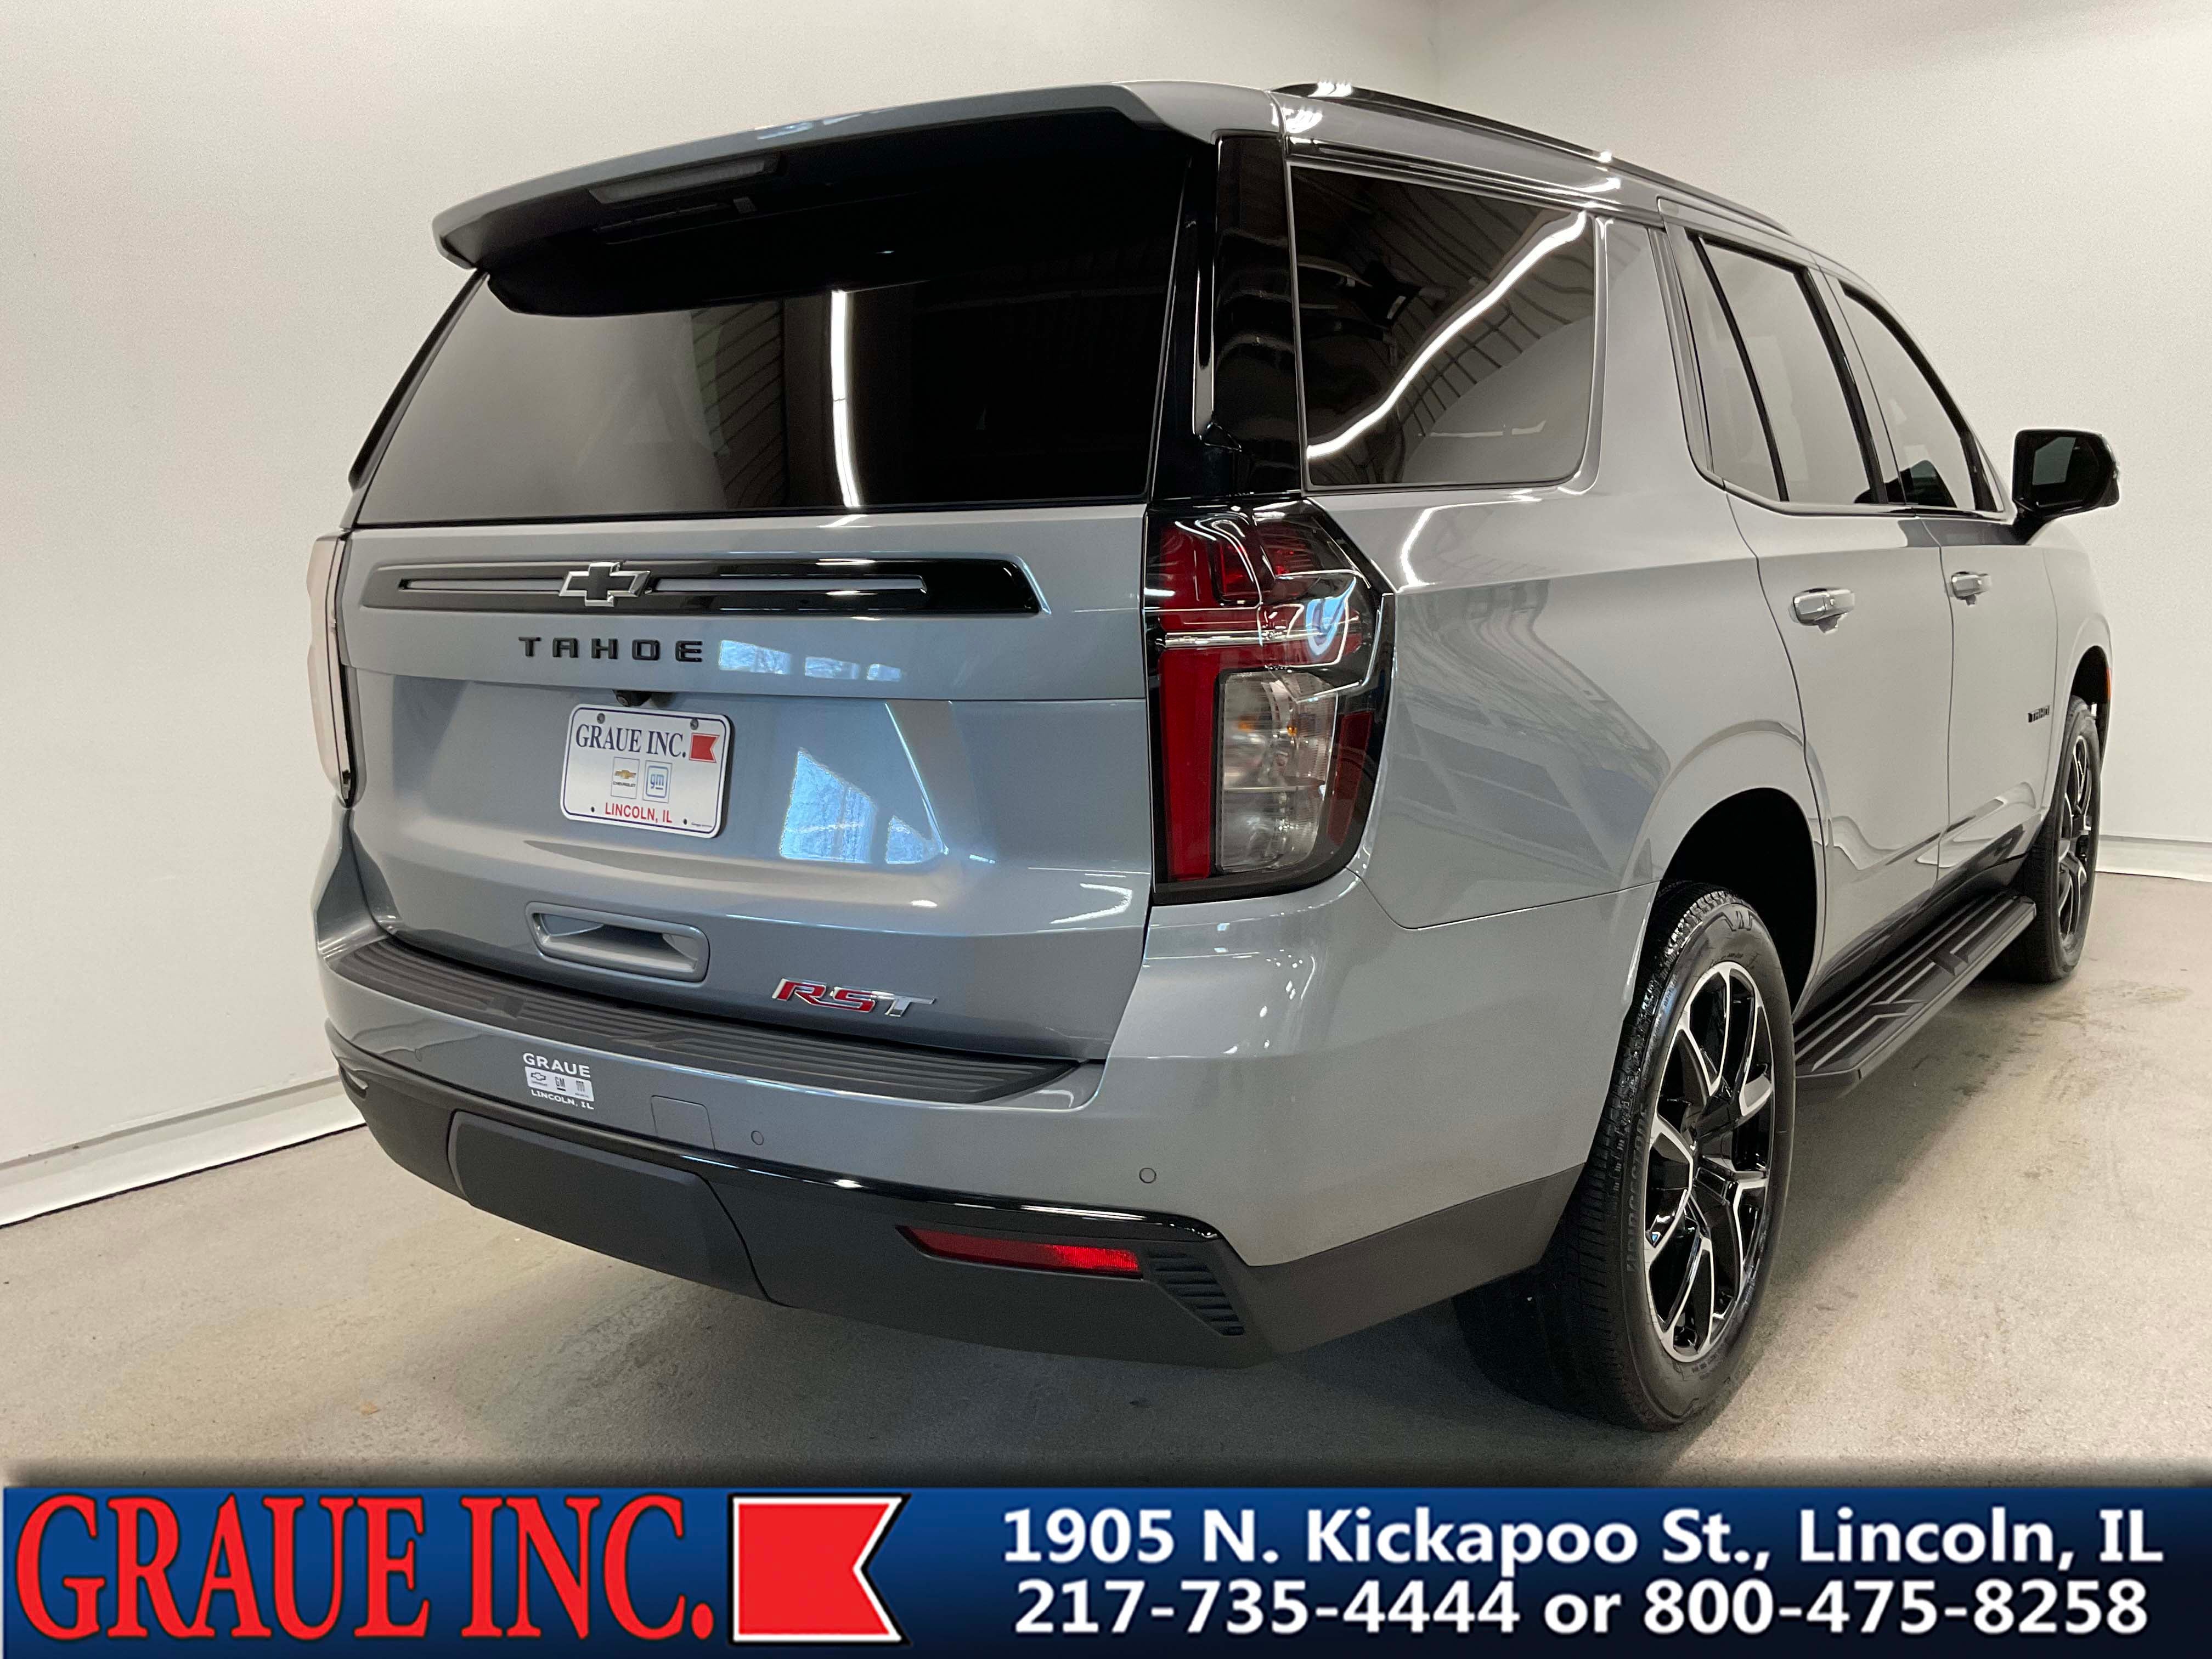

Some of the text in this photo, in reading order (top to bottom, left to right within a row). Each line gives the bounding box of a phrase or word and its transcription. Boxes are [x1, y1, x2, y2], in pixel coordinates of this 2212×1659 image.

[518, 636, 702, 662] TAHOE
[575, 724, 686, 758] GRAUE INC.
[605, 802, 672, 823] LINCOLN, IL
[771, 977, 935, 1017] RST
[522, 1052, 591, 1078] GRAUE
[555, 1076, 566, 1088] GM
[581, 1101, 594, 1110] IL
